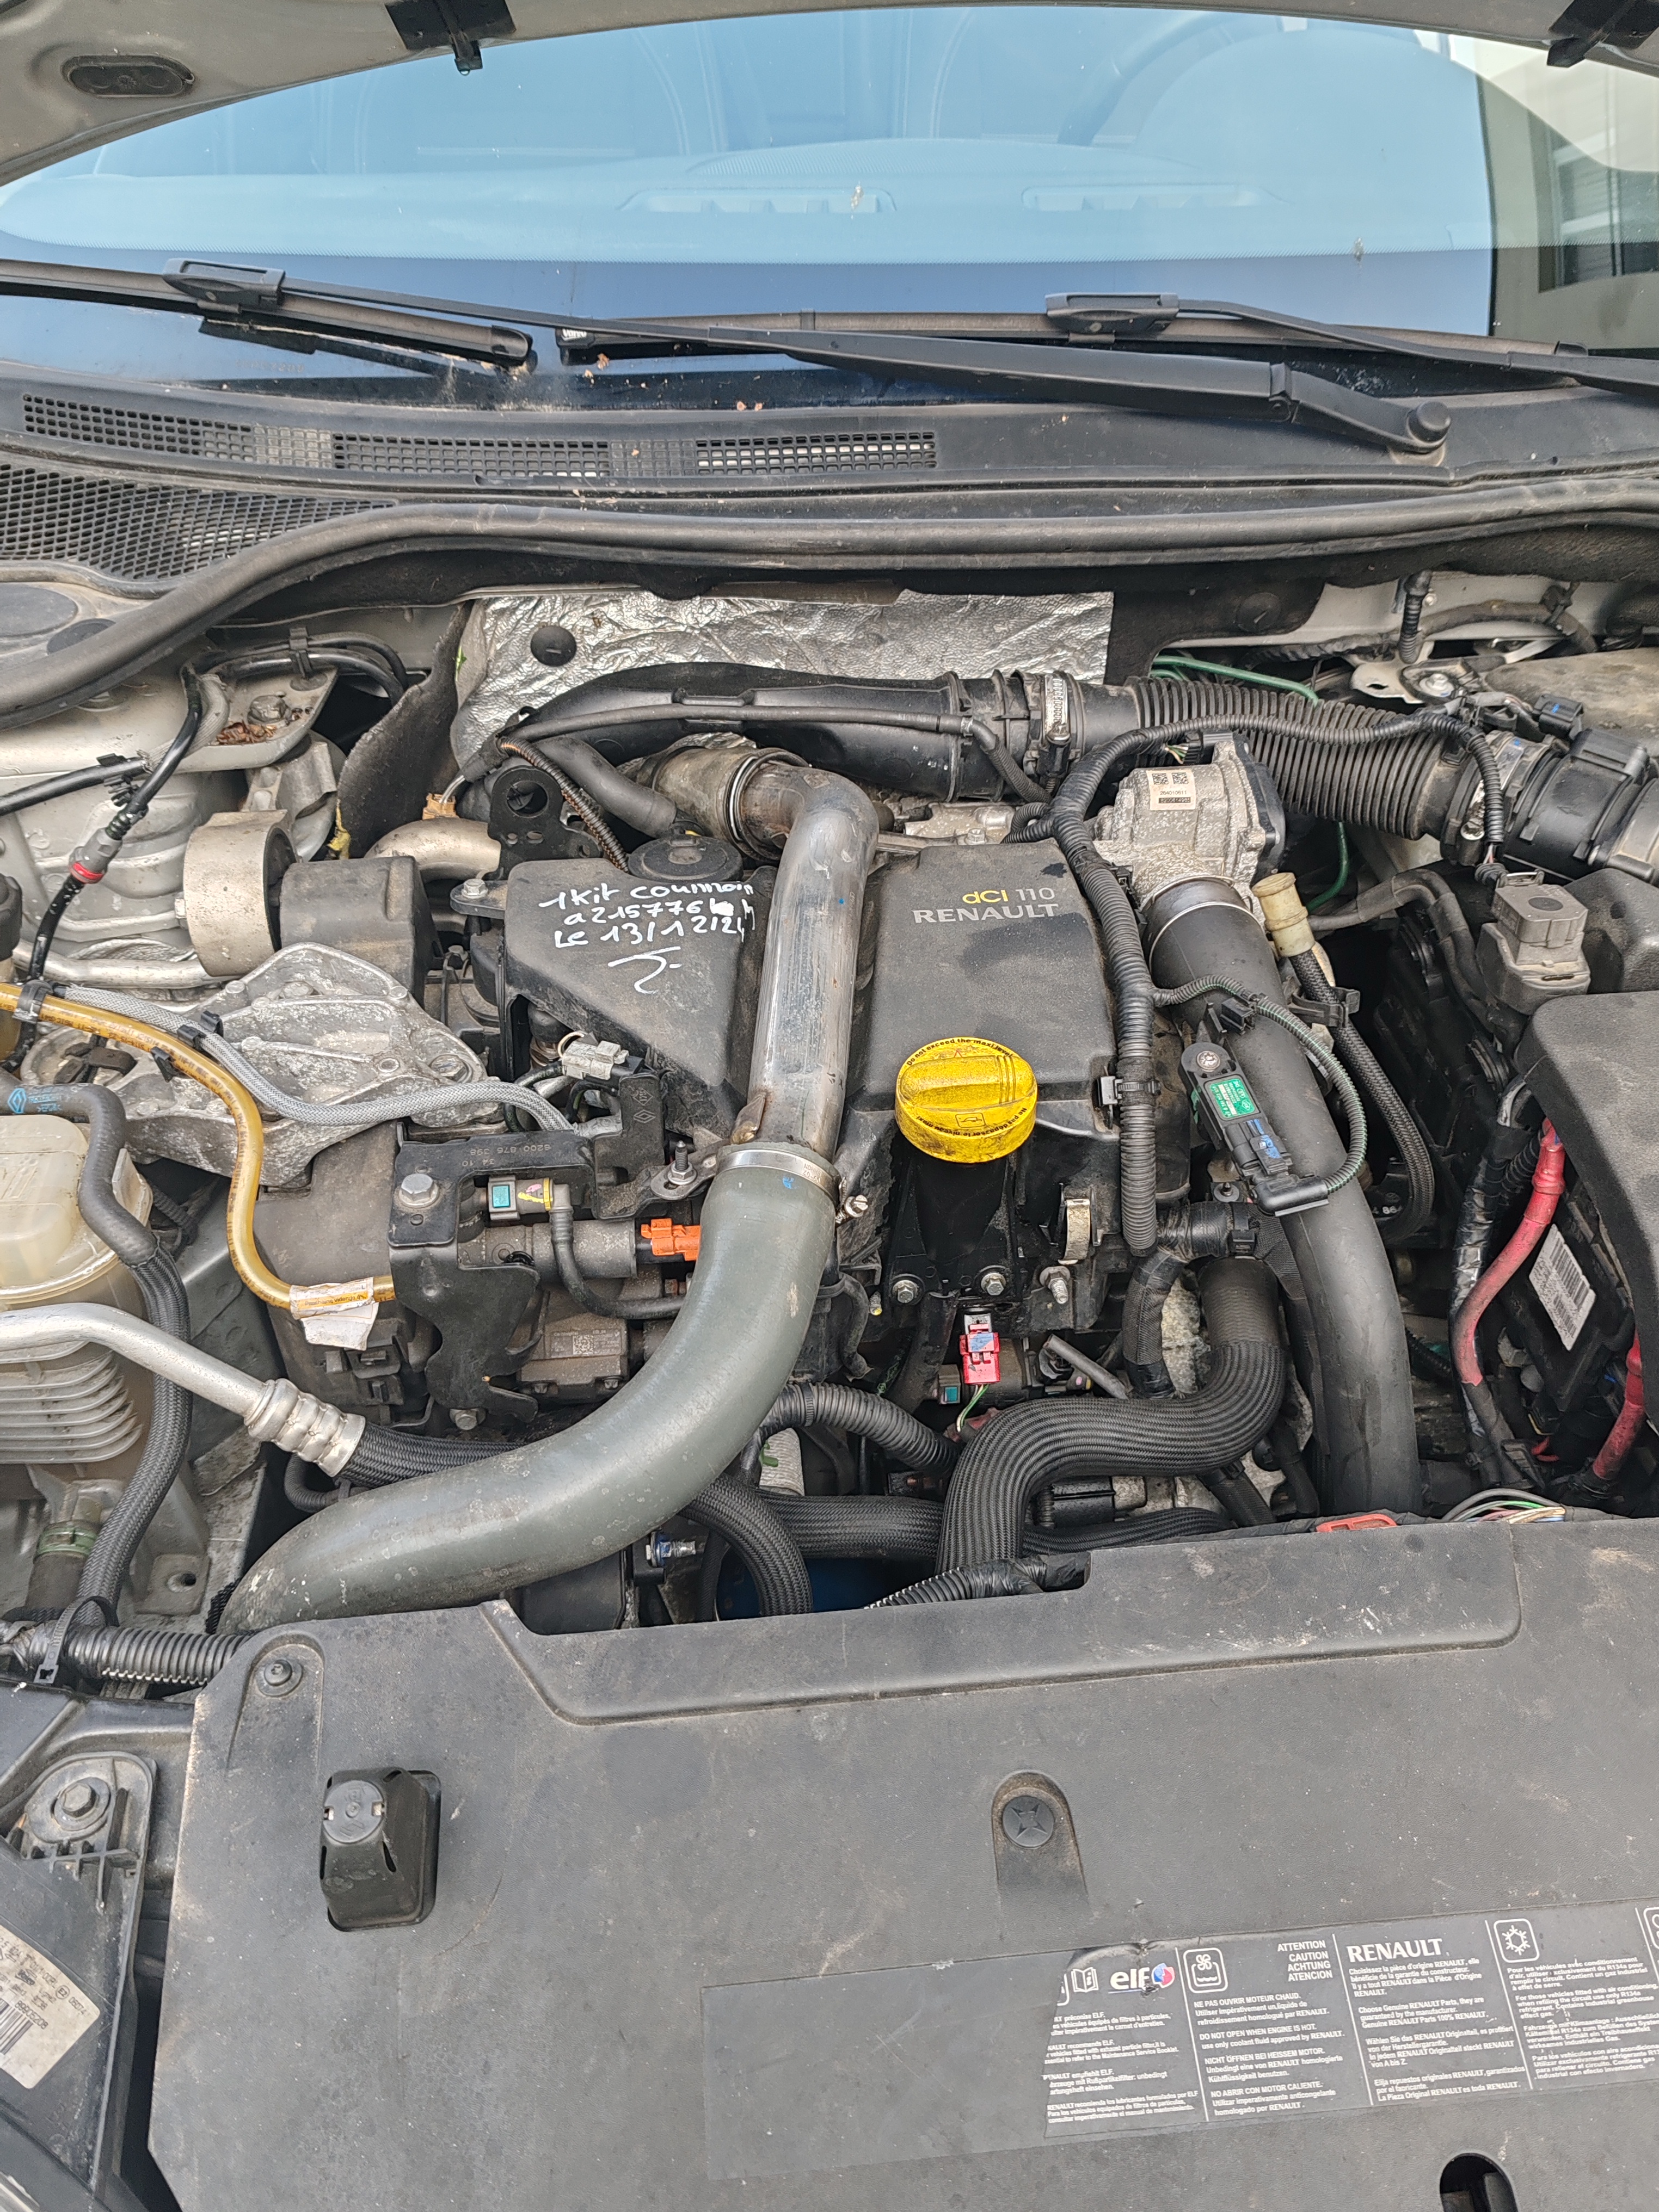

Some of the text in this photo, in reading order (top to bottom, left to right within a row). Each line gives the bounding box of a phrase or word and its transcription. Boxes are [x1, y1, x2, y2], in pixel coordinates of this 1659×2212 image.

[1015, 887, 1055, 901] 110
[912, 904, 1059, 924] RENAULT
[906, 1057, 915, 1066] Do
[915, 1049, 926, 1058] not
[926, 1039, 955, 1050] exceed
[973, 1039, 994, 1048] maxi
[994, 1043, 1013, 1057] level
[1018, 1107, 1027, 1116] Ne
[916, 1115, 933, 1128] maxi
[1007, 1114, 1018, 1125] pas
[934, 1126, 960, 1136] niveau
[972, 1122, 1009, 1136] dépasser
[1277, 1940, 1326, 1952] ATTENTION
[1346, 1938, 1442, 1962] RENAULT
[1289, 1951, 1329, 1962] CAUTION
[1287, 1961, 1331, 1971] ACHTUNG
[1110, 1967, 1150, 1990] elf
[1288, 1970, 1333, 1982] ATENCION
[59, 1988, 67, 1996] E2
[1219, 1997, 1245, 2005] OUVRIR
[1246, 1994, 1274, 2003] MOTEUR
[1275, 1992, 1300, 2000] CHAUD.
[1219, 2004, 1267, 2016] impérativement
[1276, 2001, 1298, 2011] liquide
[1197, 2014, 1247, 2025] refroidissement
[1248, 2012, 1283, 2022] homologué
[1296, 2007, 1329, 2016] RENAULT.
[1267, 2026, 1293, 2034] ENGINE
[1215, 2041, 1229, 2049] only
[1270, 2035, 1300, 2044] approved
[1301, 2033, 1310, 2042] by
[1311, 2030, 1344, 2039] RENAULT.
[1226, 2053, 1254, 2062] ÖFFNEN
[1267, 2050, 1298, 2059] HEISSEM
[1298, 2047, 1324, 2055] MOTOR.
[1206, 2064, 1239, 2074] Unbedingt
[1268, 2059, 1299, 2067] RENAULT
[1301, 2055, 1343, 2066] homologierte
[1208, 2069, 1289, 2084] Kühlflüssigkeit benutzen.
[1261, 2085, 1286, 2093] MOTOR
[1214, 2105, 1255, 2117] homologado
